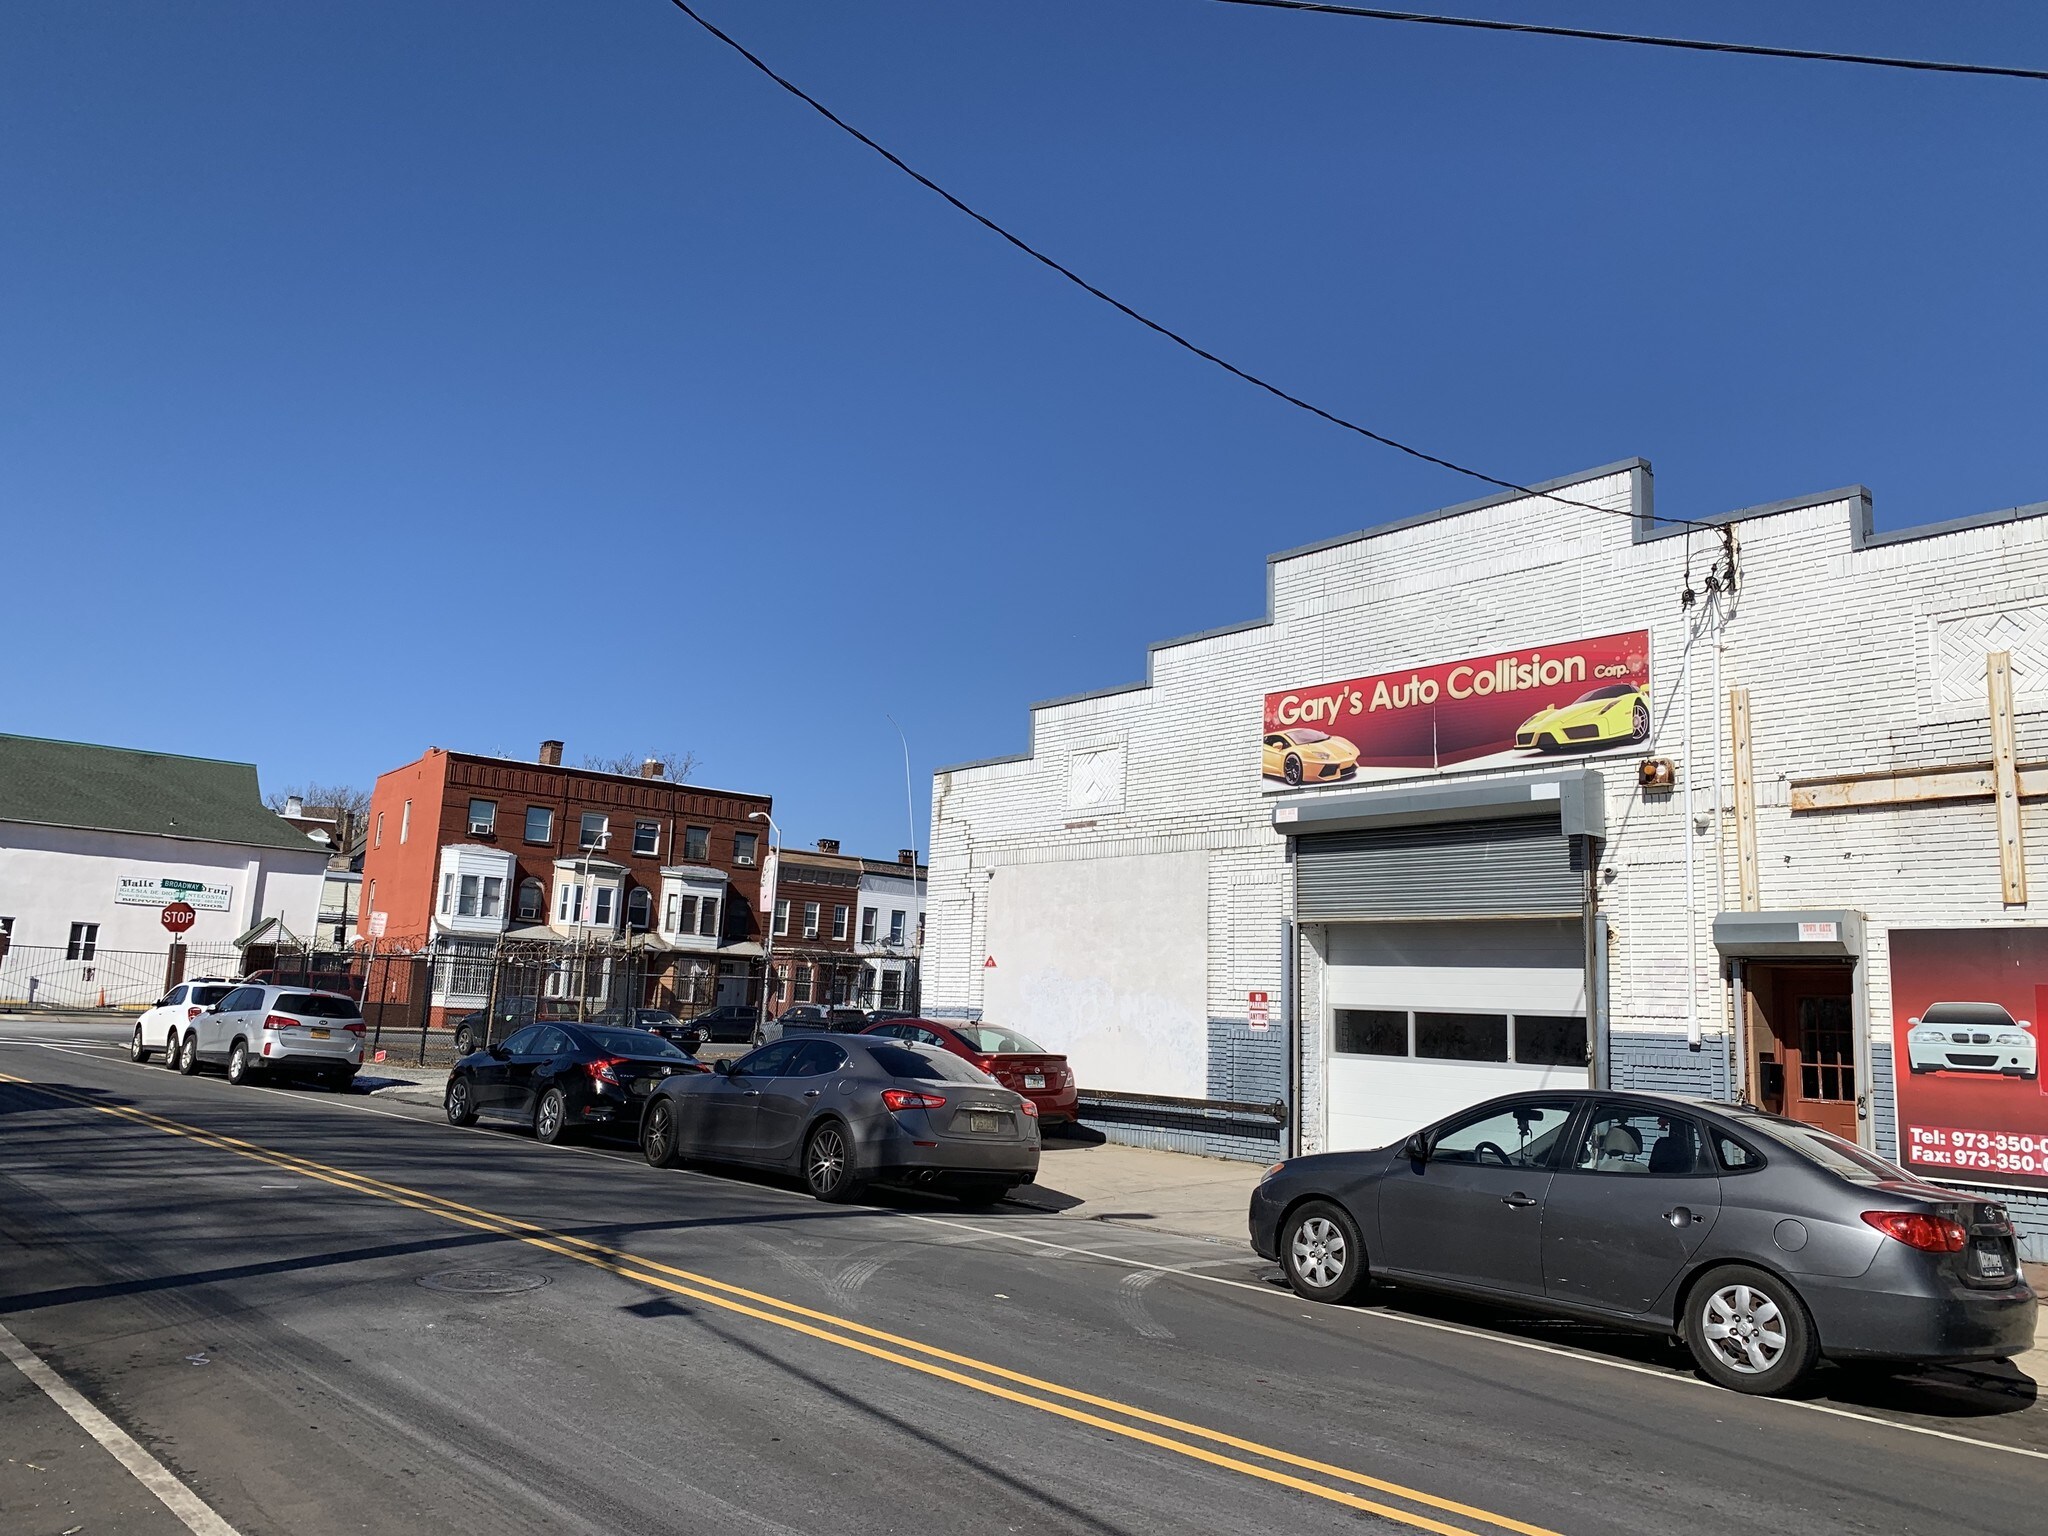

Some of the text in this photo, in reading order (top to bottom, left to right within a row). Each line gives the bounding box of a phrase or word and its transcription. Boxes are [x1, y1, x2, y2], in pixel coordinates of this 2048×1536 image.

[1277, 653, 1631, 726] Gary's Auto Collision Corp.
[121, 879, 154, 887] Valle
[164, 880, 200, 890] BROADWAY
[163, 911, 194, 923] STOP
[1250, 1012, 1268, 1020] ANYTIME
[1910, 1127, 1946, 1145] Tel:
[1911, 1145, 1951, 1163] Fax:
